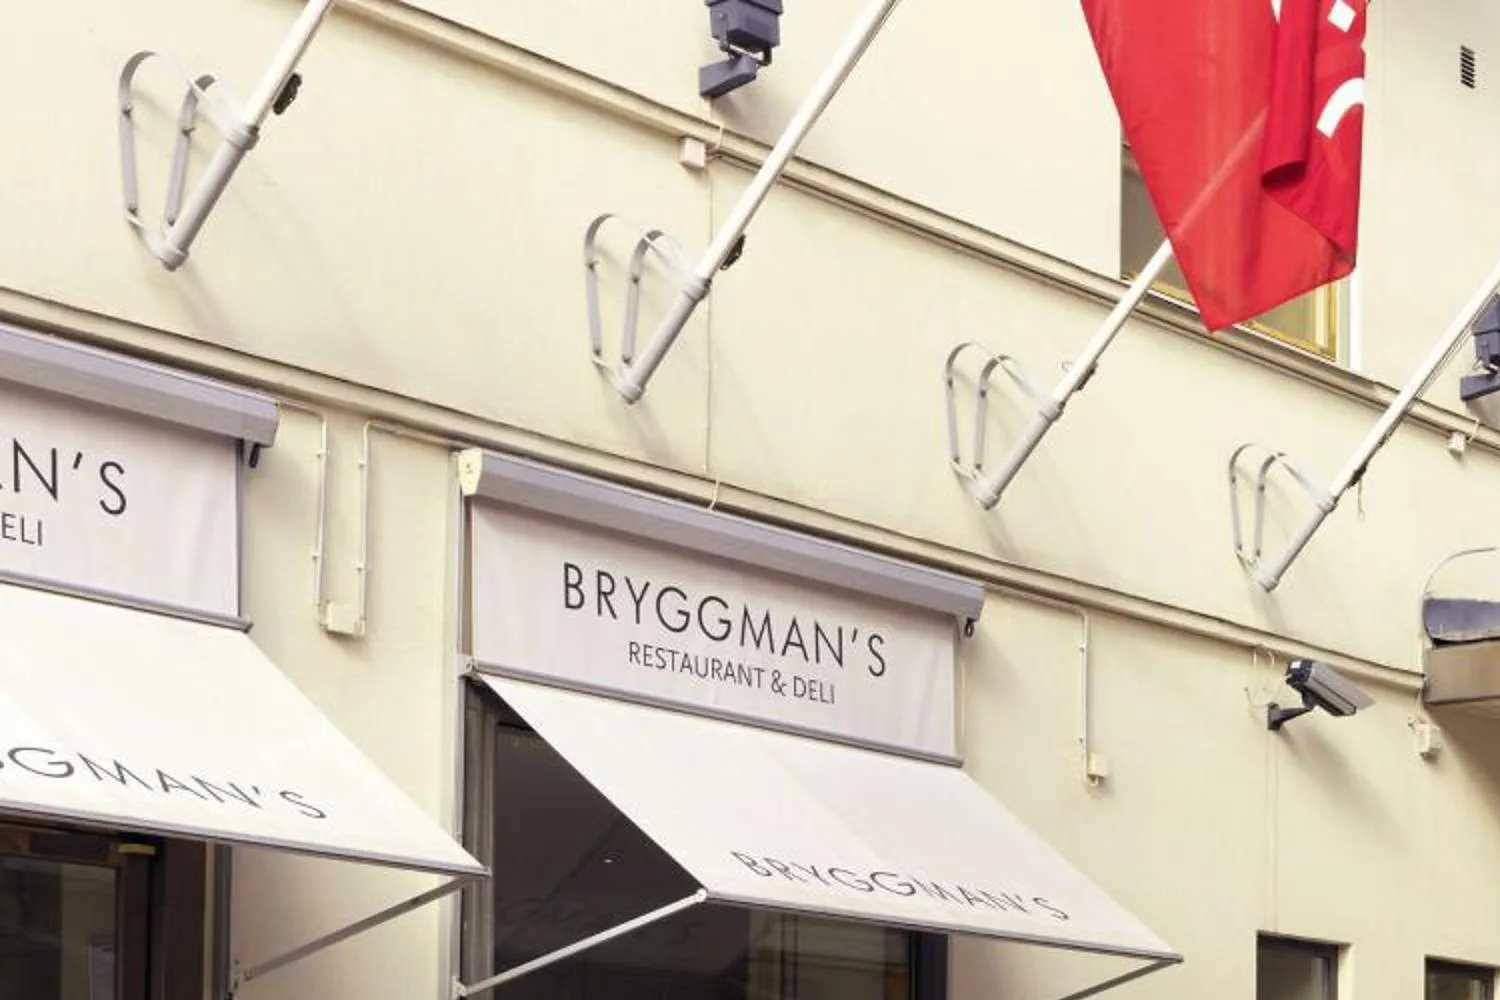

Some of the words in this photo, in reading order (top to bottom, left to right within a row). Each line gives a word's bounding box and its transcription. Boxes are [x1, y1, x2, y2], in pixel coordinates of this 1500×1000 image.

[0, 436, 128, 516] N'S
[561, 561, 887, 679] BRYGGMAN'S
[628, 640, 765, 689] RESTAURANT
[770, 668, 787, 697] &
[792, 675, 836, 705] DELI
[0, 746, 328, 819] GMAN'S
[730, 849, 1071, 922] BRYGGMAN'S
